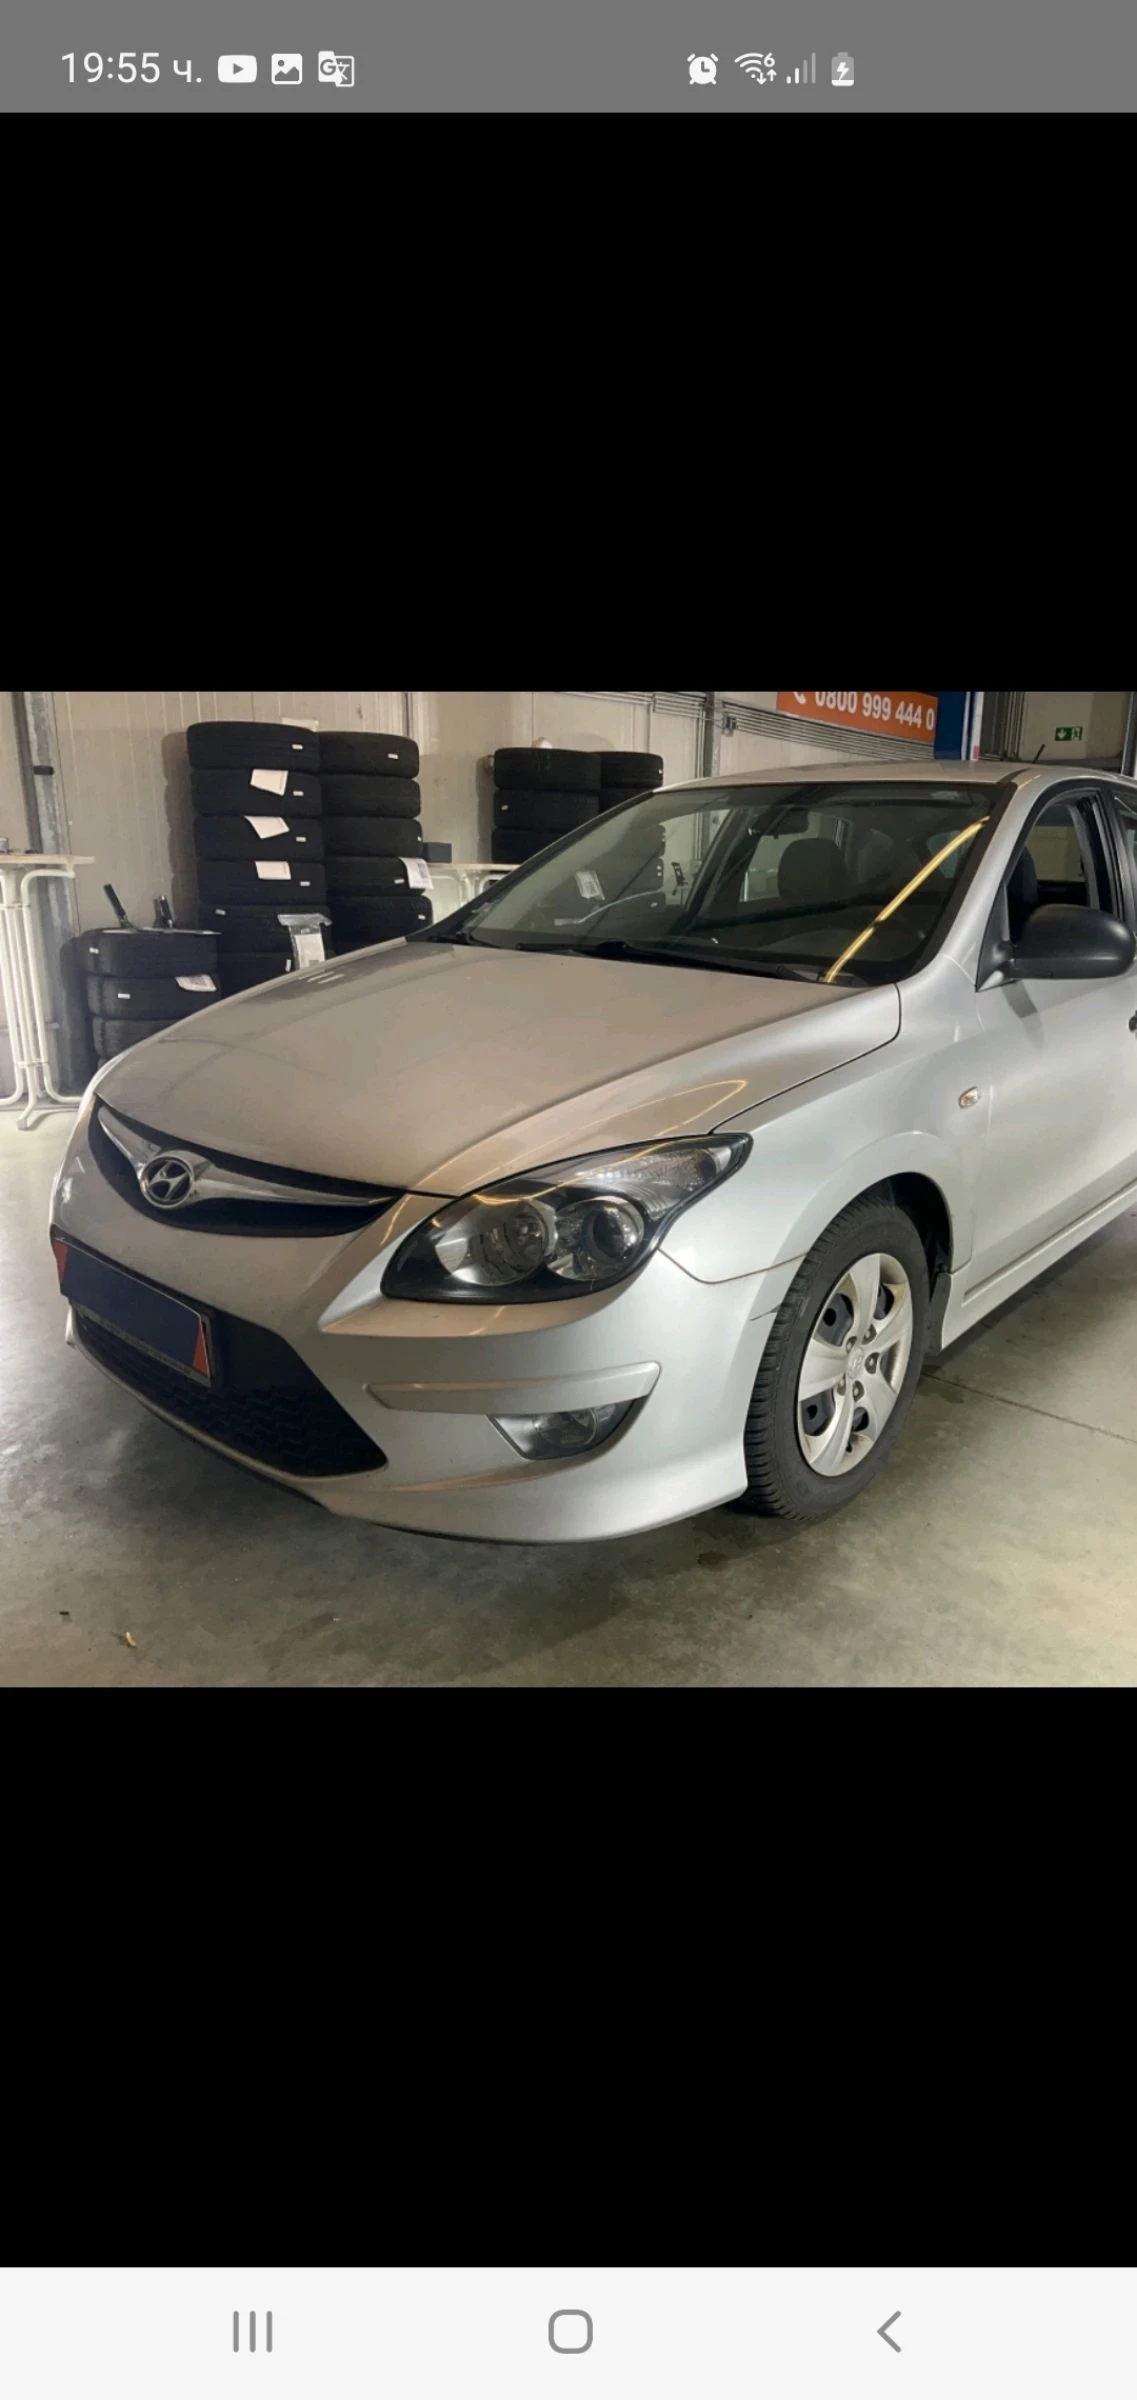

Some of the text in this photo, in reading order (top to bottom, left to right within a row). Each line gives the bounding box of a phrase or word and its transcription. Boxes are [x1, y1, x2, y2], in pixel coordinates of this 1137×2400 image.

[814, 691, 935, 731] 0800 999 444 0
